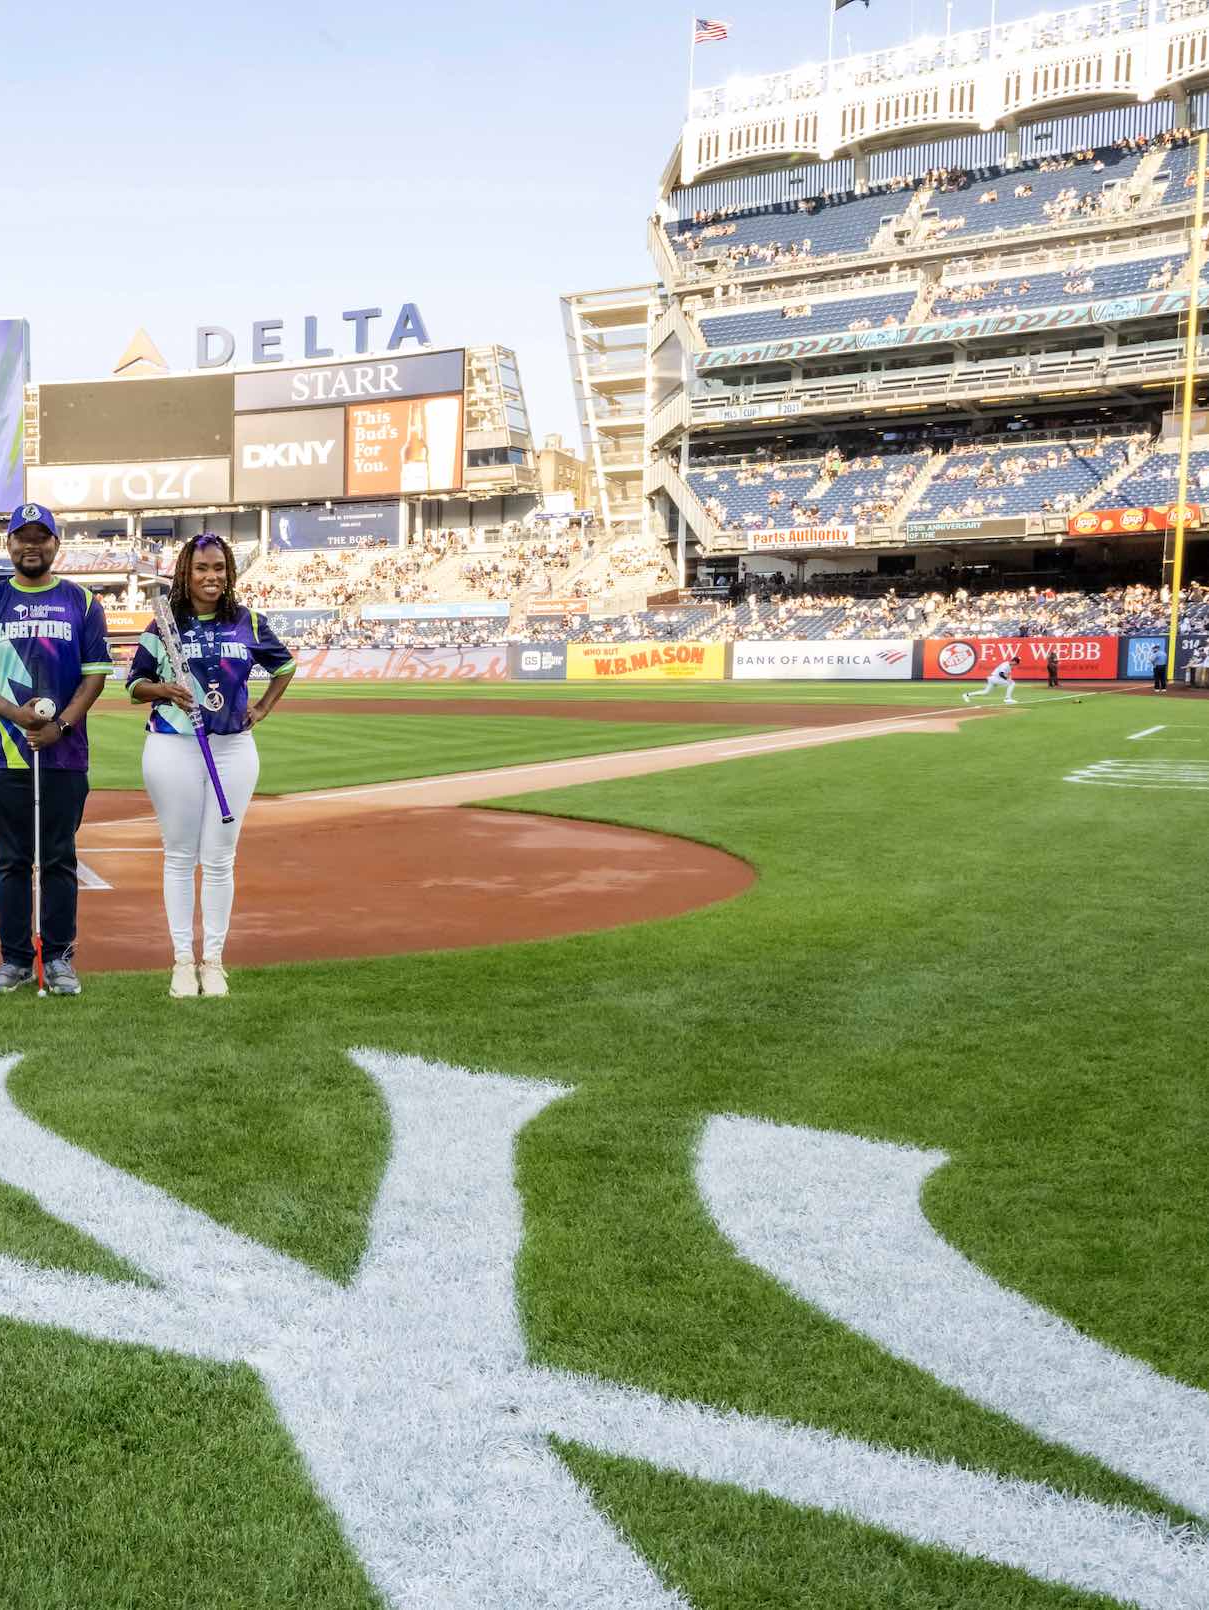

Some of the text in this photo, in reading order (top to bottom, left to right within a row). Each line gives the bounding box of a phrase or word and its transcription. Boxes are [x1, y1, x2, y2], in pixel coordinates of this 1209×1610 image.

[197, 302, 432, 370] DELTA
[291, 364, 403, 401] STARR
[354, 410, 391, 426] This
[354, 426, 399, 442] Bud's
[242, 440, 335, 469] DKNY
[354, 442, 381, 458] For
[354, 458, 388, 473] You.
[102, 464, 205, 502] razr
[926, 521, 983, 532] ANNIVERSARY
[327, 536, 346, 545] THE
[753, 526, 849, 545] Parts Authority
[909, 530, 936, 540] OF THE
[105, 617, 134, 625] OYOTA
[583, 648, 601, 656] WHO
[980, 642, 1101, 661] F.W. WEBB
[737, 655, 871, 665] BANK OF AMERICA
